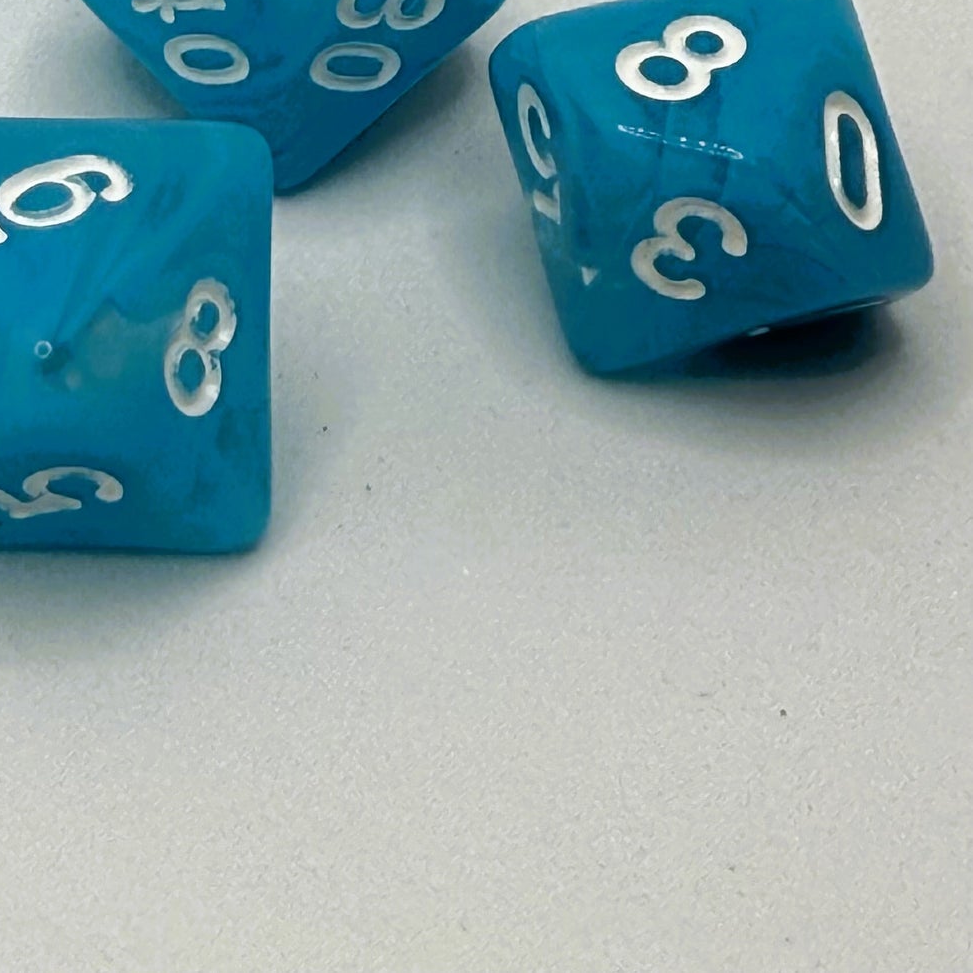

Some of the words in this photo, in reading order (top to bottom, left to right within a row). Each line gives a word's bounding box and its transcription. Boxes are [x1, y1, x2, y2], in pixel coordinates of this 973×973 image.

[615, 14, 747, 101] 8
[824, 90, 883, 230] 0
[630, 196, 748, 300] 3
[164, 276, 237, 417] 8
